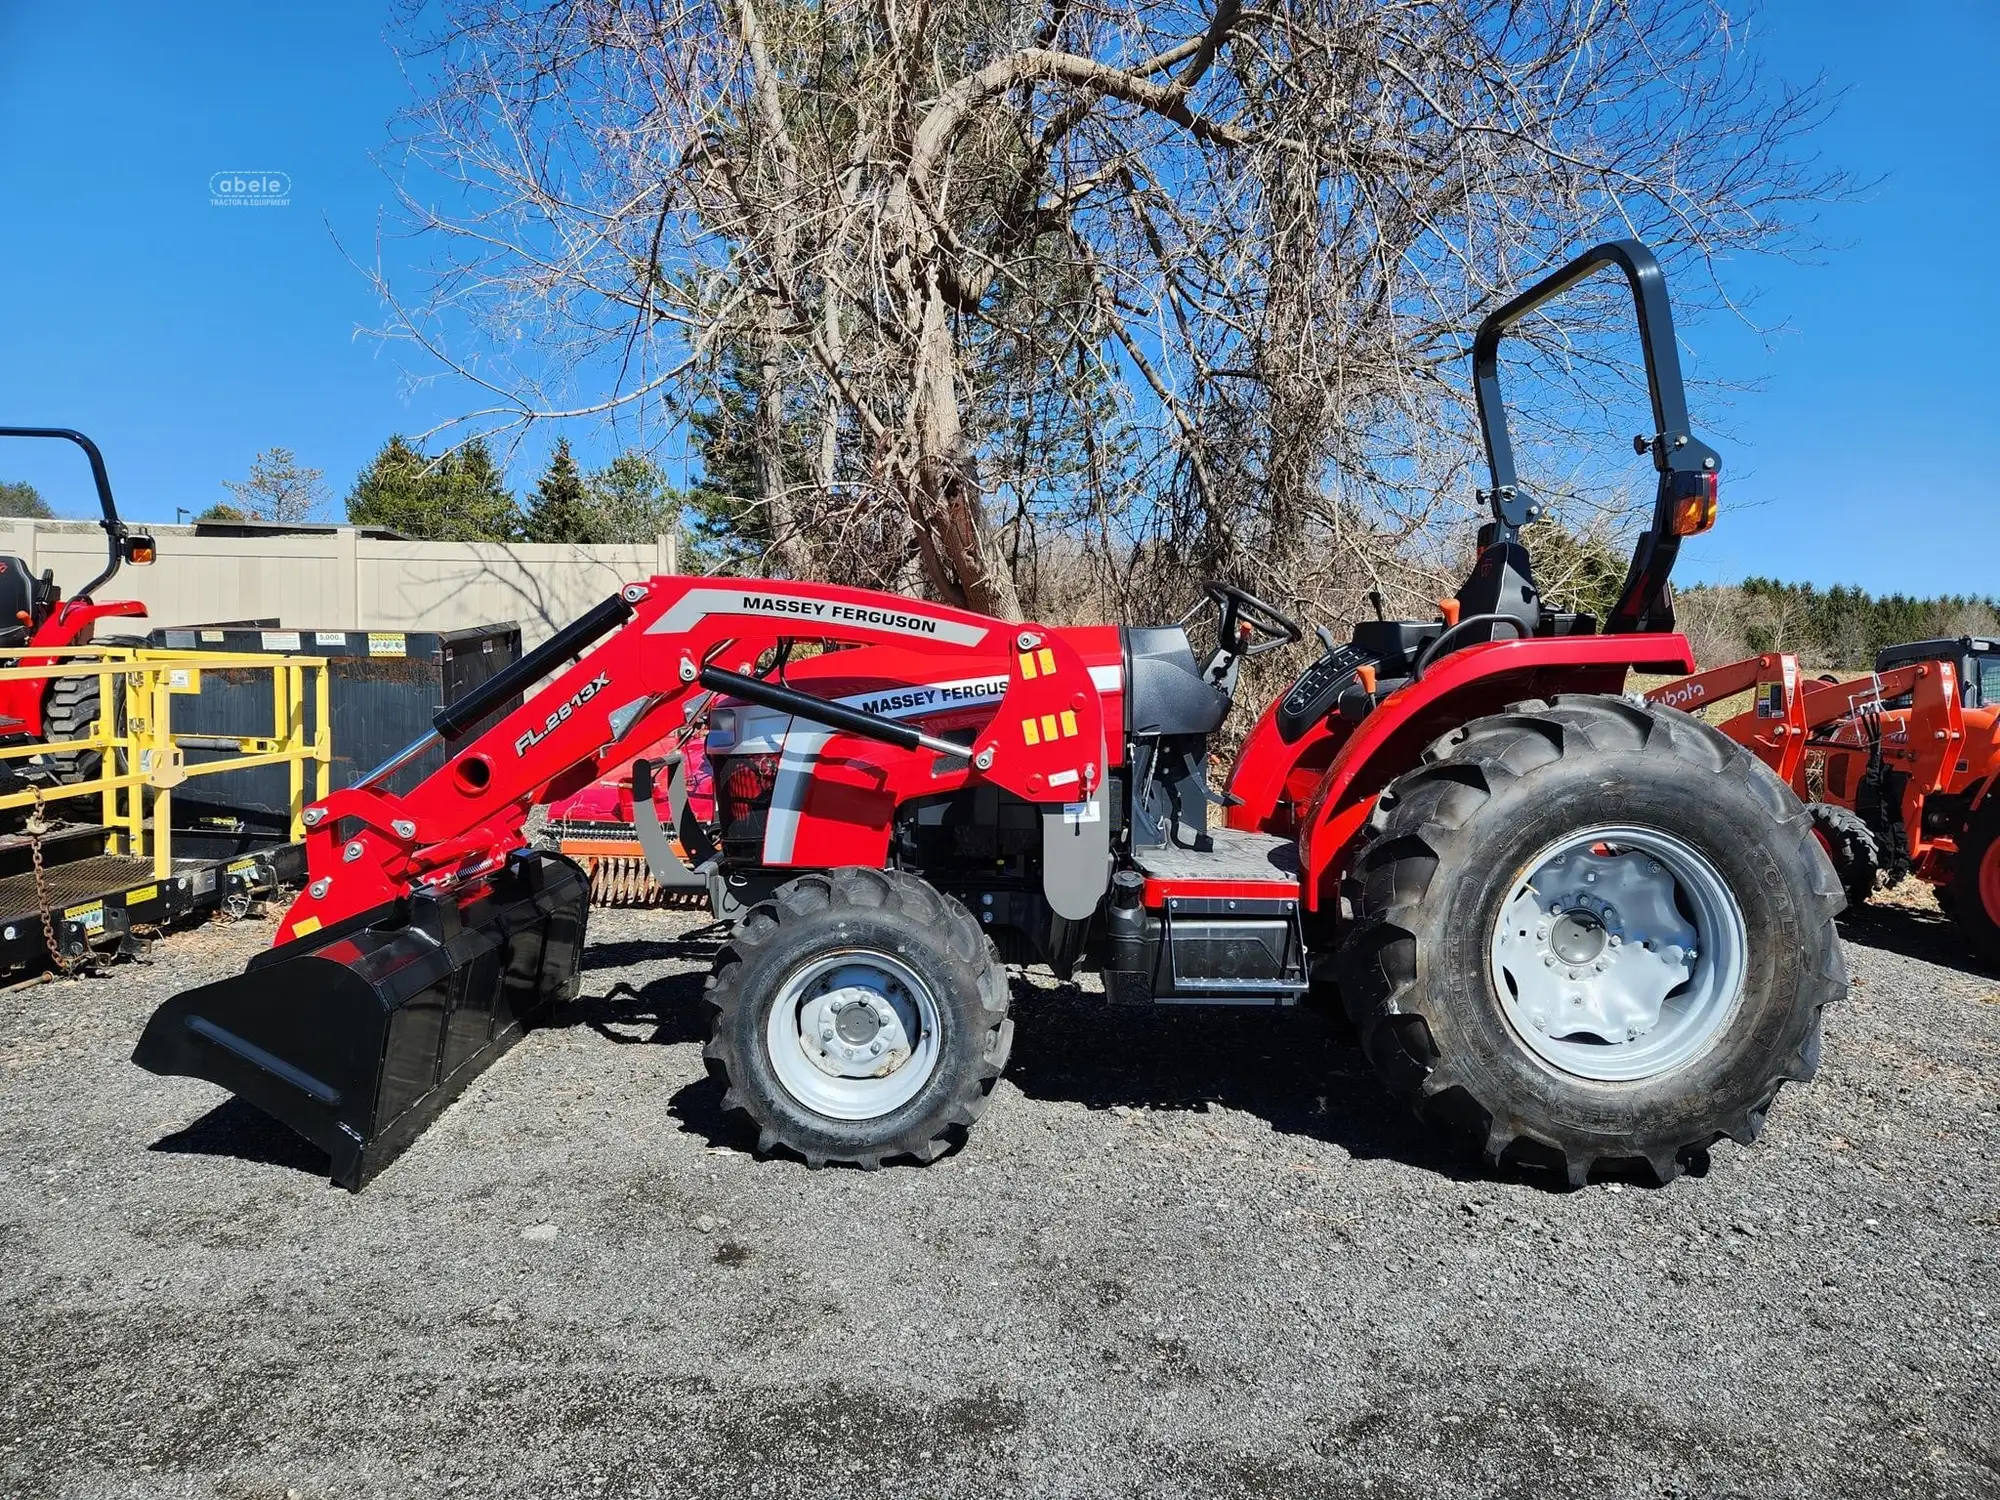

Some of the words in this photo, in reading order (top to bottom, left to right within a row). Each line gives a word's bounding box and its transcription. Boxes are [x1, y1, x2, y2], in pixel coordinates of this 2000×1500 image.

[743, 596, 826, 615] MASSEY
[832, 606, 936, 633] FERGUSON
[513, 671, 611, 757] FL.2813X
[862, 689, 936, 714] MASSEY
